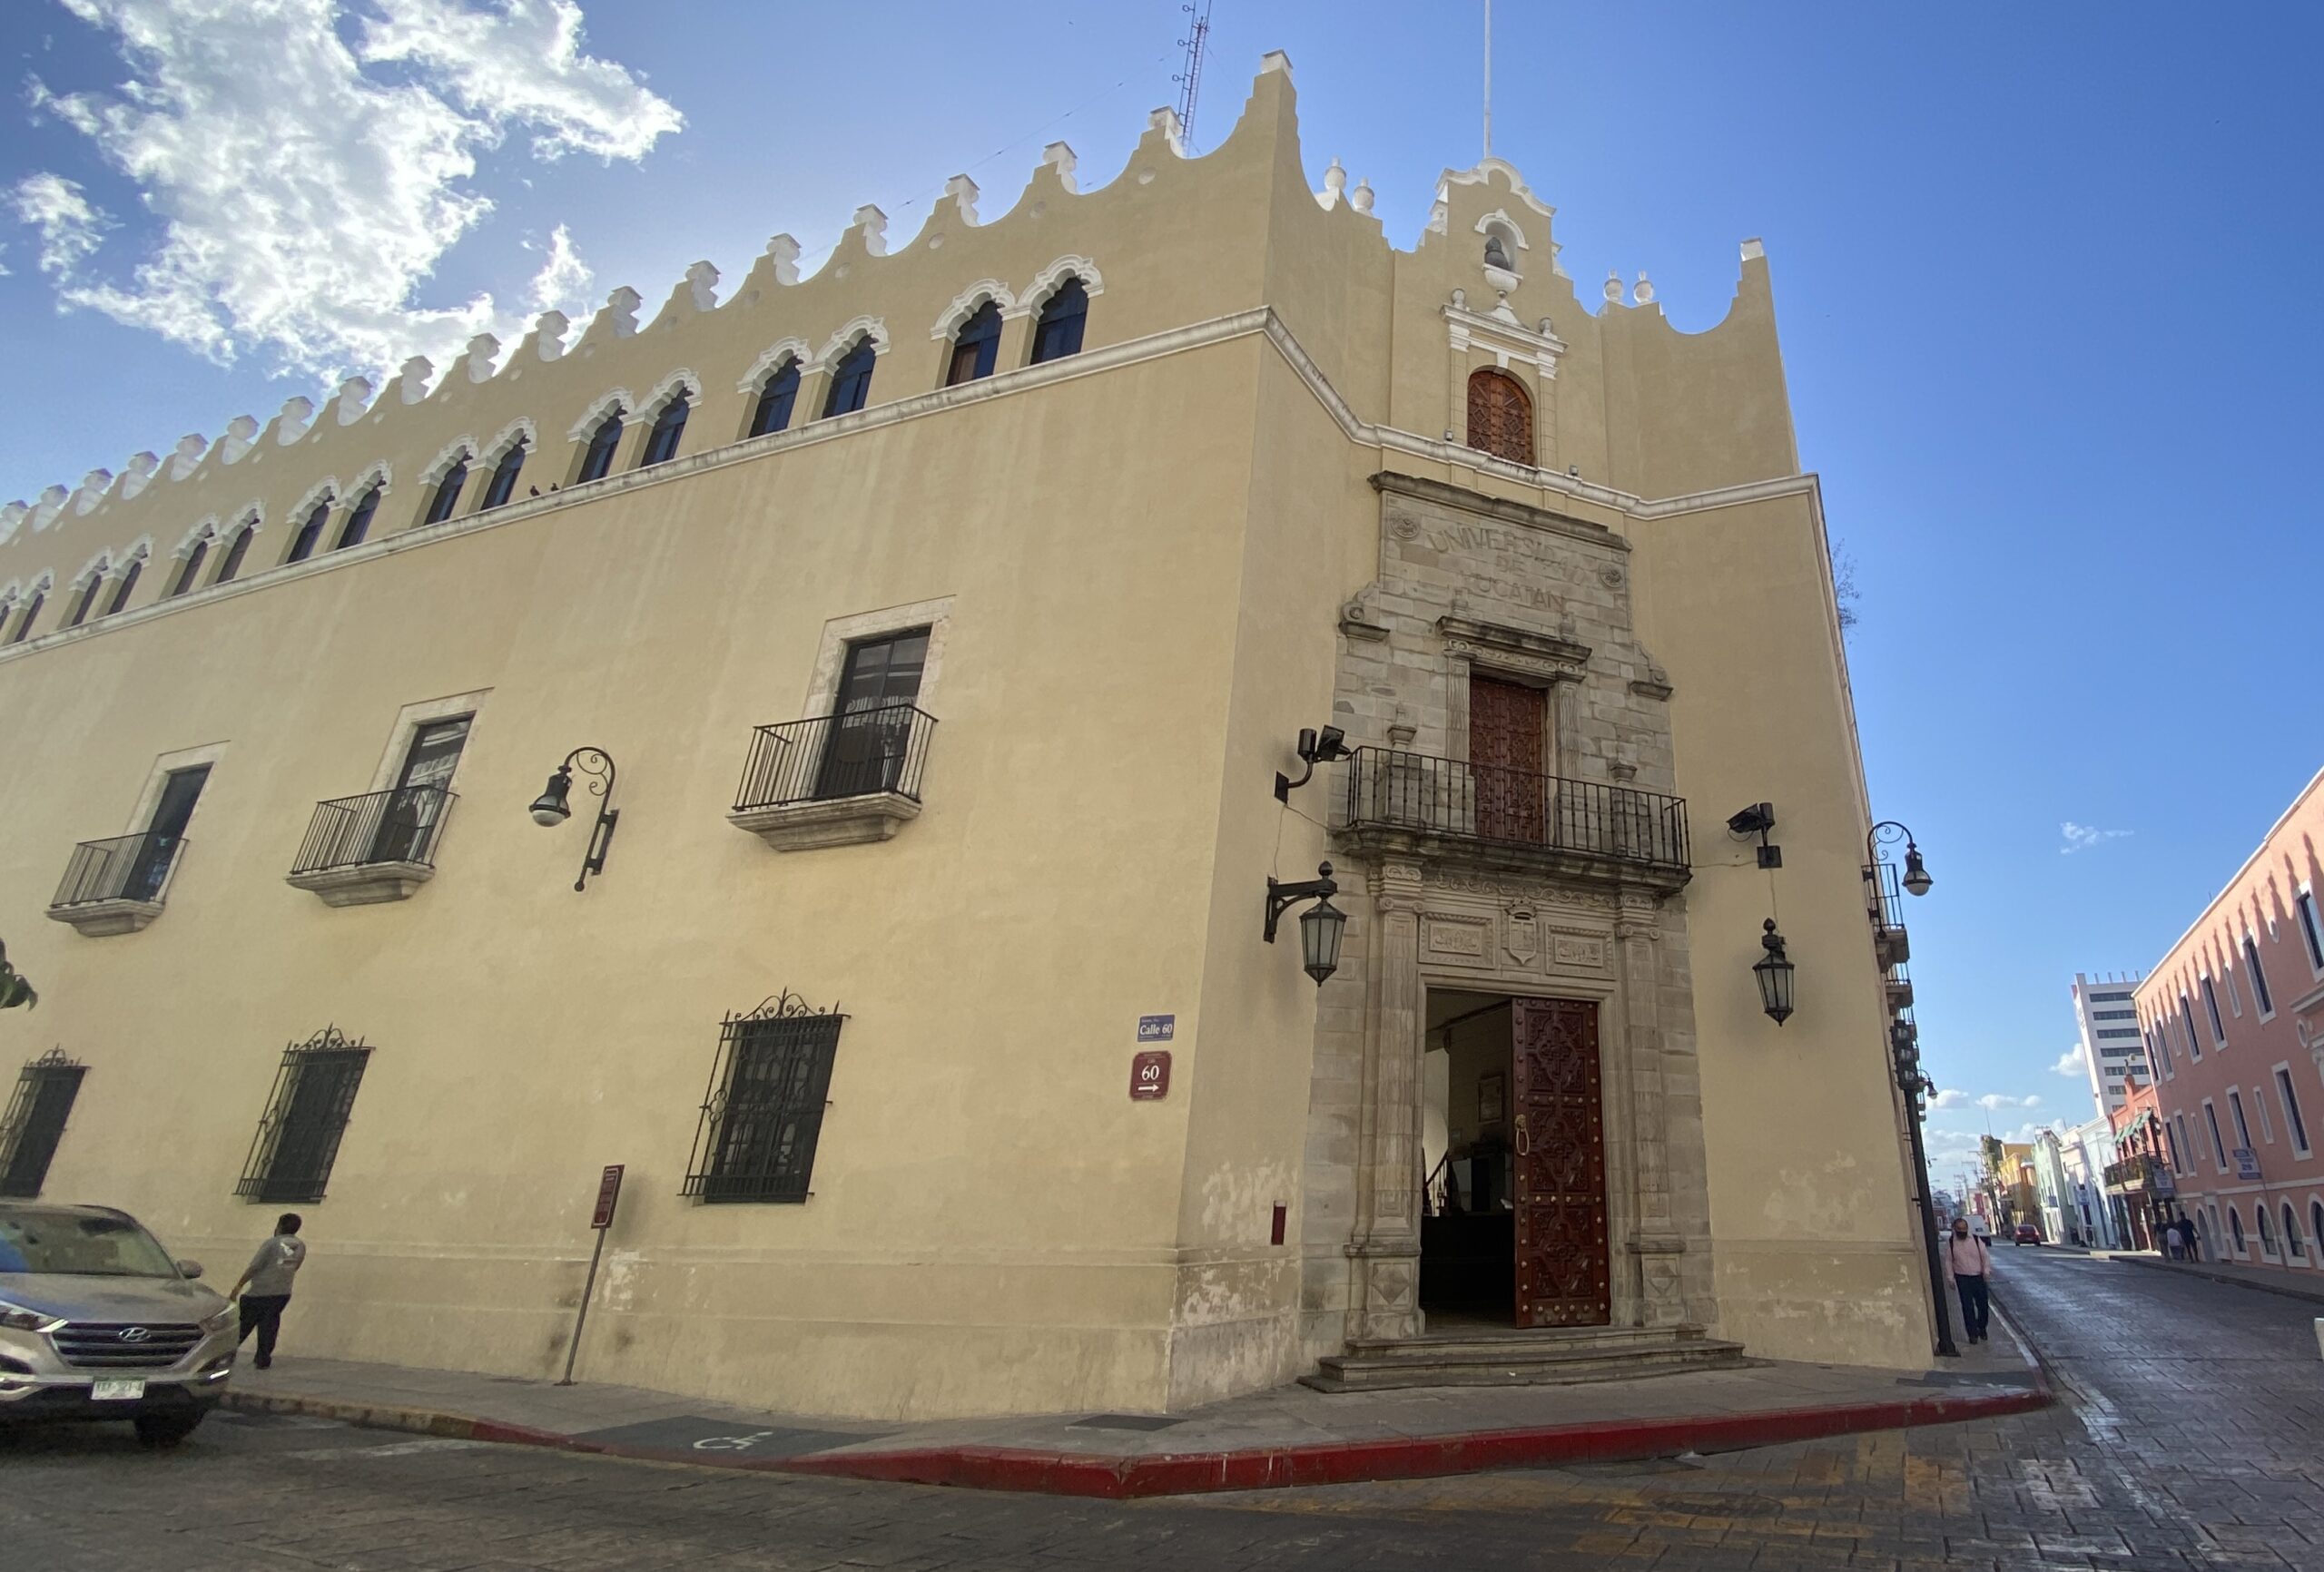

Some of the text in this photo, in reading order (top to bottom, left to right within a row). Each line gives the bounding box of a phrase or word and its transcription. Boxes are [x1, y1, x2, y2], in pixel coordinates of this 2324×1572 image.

[1495, 555, 1527, 578] DE
[1465, 574, 1563, 609] UCATAN
[1139, 1023, 1173, 1035] Calle 60
[1141, 1065, 1159, 1081] 60
